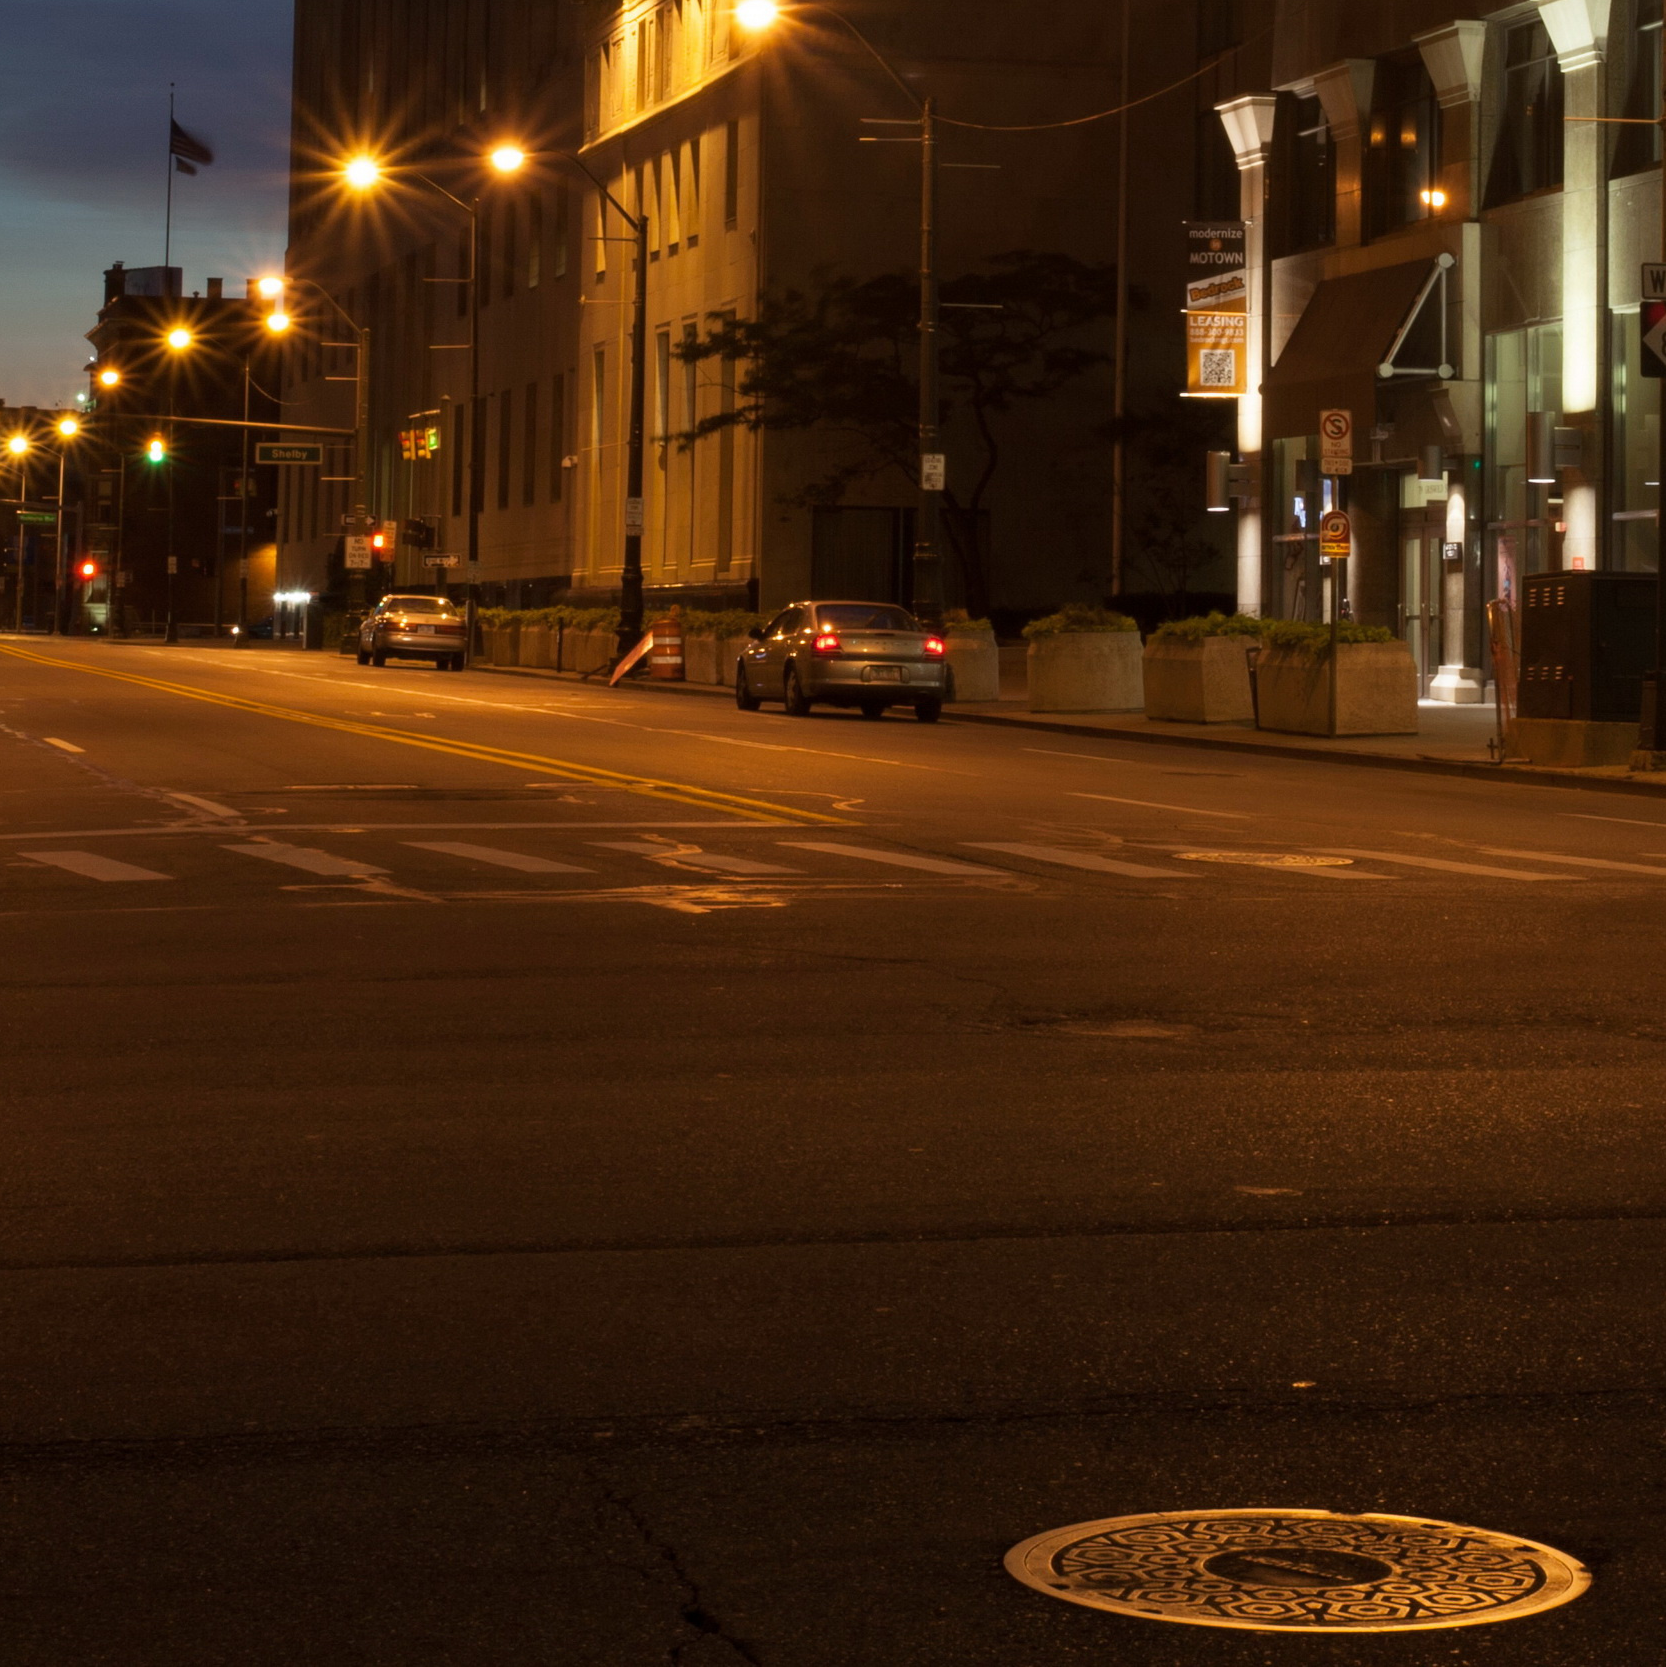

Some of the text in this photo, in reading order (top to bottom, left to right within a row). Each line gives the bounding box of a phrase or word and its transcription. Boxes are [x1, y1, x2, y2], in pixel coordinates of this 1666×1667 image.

[1189, 227, 1243, 239] modernize
[1189, 251, 1243, 265] MOTOWN
[1189, 276, 1245, 302] Bedrock
[1189, 315, 1244, 327] LEASING
[272, 449, 308, 460] Shelby
